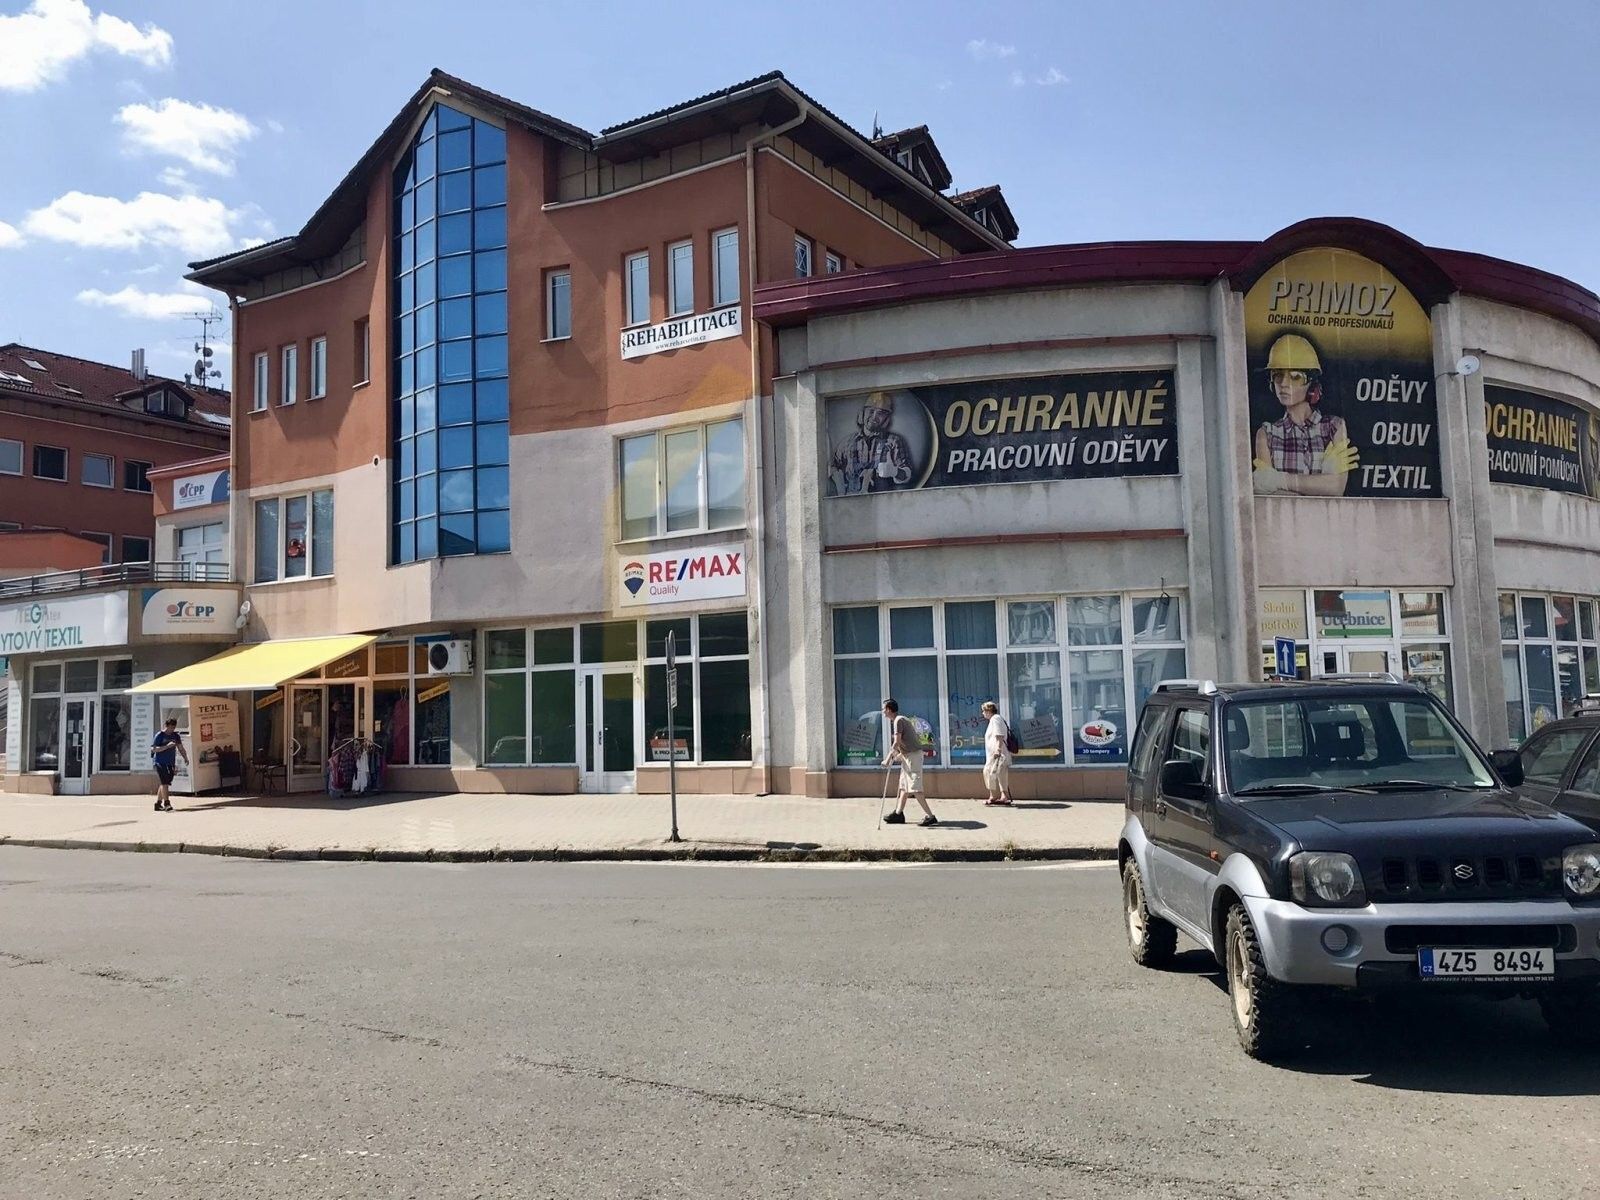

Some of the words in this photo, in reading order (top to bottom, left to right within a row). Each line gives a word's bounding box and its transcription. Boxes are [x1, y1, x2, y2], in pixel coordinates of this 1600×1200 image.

[1269, 278, 1397, 317] PRIMOZ
[626, 309, 738, 348] REHABILITACE
[1268, 313, 1311, 326] OCHRANA
[1313, 317, 1326, 327] OD
[1356, 374, 1429, 404] ODĚVY
[943, 379, 1168, 438] OCHRANNÉ
[1371, 421, 1431, 447] OBUV
[947, 436, 1077, 473] PRACOVNÍ
[1082, 433, 1168, 464] ODĚVY
[1487, 448, 1538, 476] RACOVNÍ
[189, 483, 205, 497] ČPP
[1361, 464, 1431, 490] TEXTIL
[649, 552, 742, 584] RE/MAX
[649, 584, 680, 597] Quality
[184, 602, 215, 617] ČPP
[0, 625, 42, 652] YTOVÝ
[45, 625, 83, 648] TEXTIL
[198, 703, 231, 714] TEXTIL
[1422, 965, 1433, 973] CZ
[1438, 951, 1477, 973] 4Z5
[1493, 950, 1545, 972] 8494
